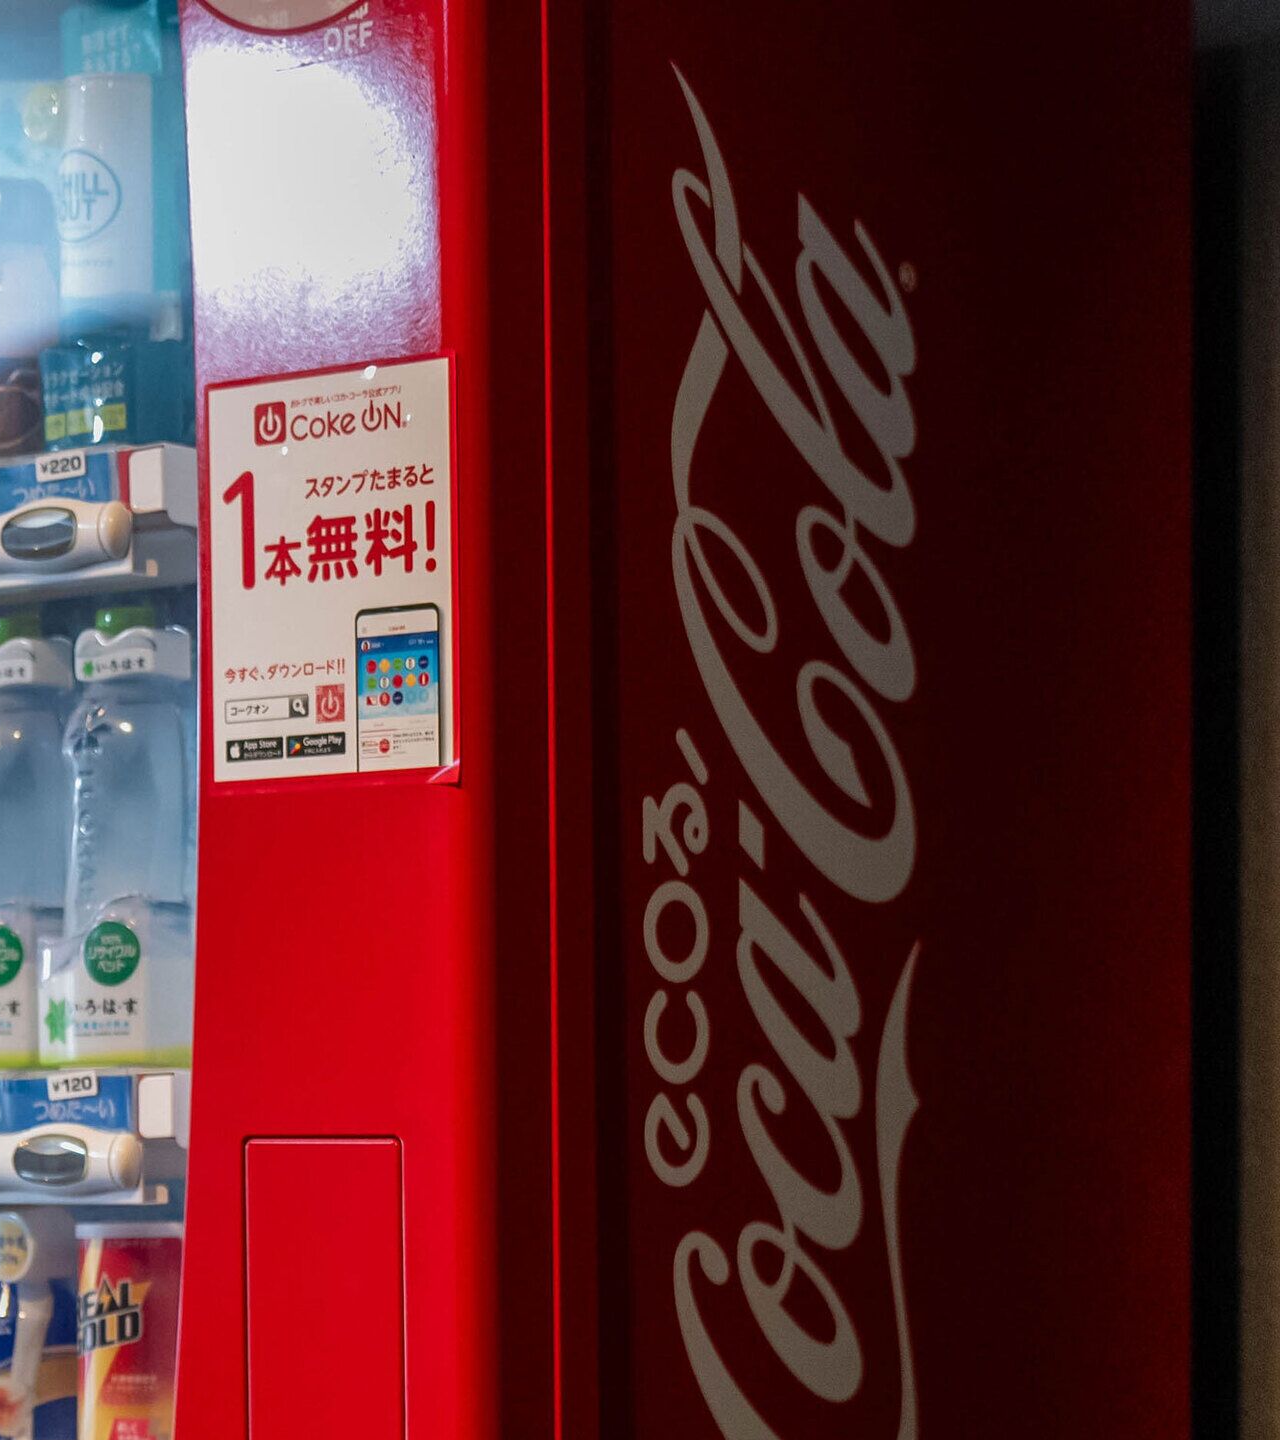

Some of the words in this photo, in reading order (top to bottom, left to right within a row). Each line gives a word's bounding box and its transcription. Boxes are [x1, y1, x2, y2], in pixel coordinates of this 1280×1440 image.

[323, 20, 373, 54] OFF
[290, 411, 356, 440] Coke
[40, 456, 81, 474] ¥220
[305, 464, 435, 499] スタンプたまると
[243, 741, 260, 751] App
[261, 739, 277, 749] Store
[303, 736, 328, 748] Google
[329, 734, 342, 746] Play
[52, 1076, 92, 1092] ¥120
